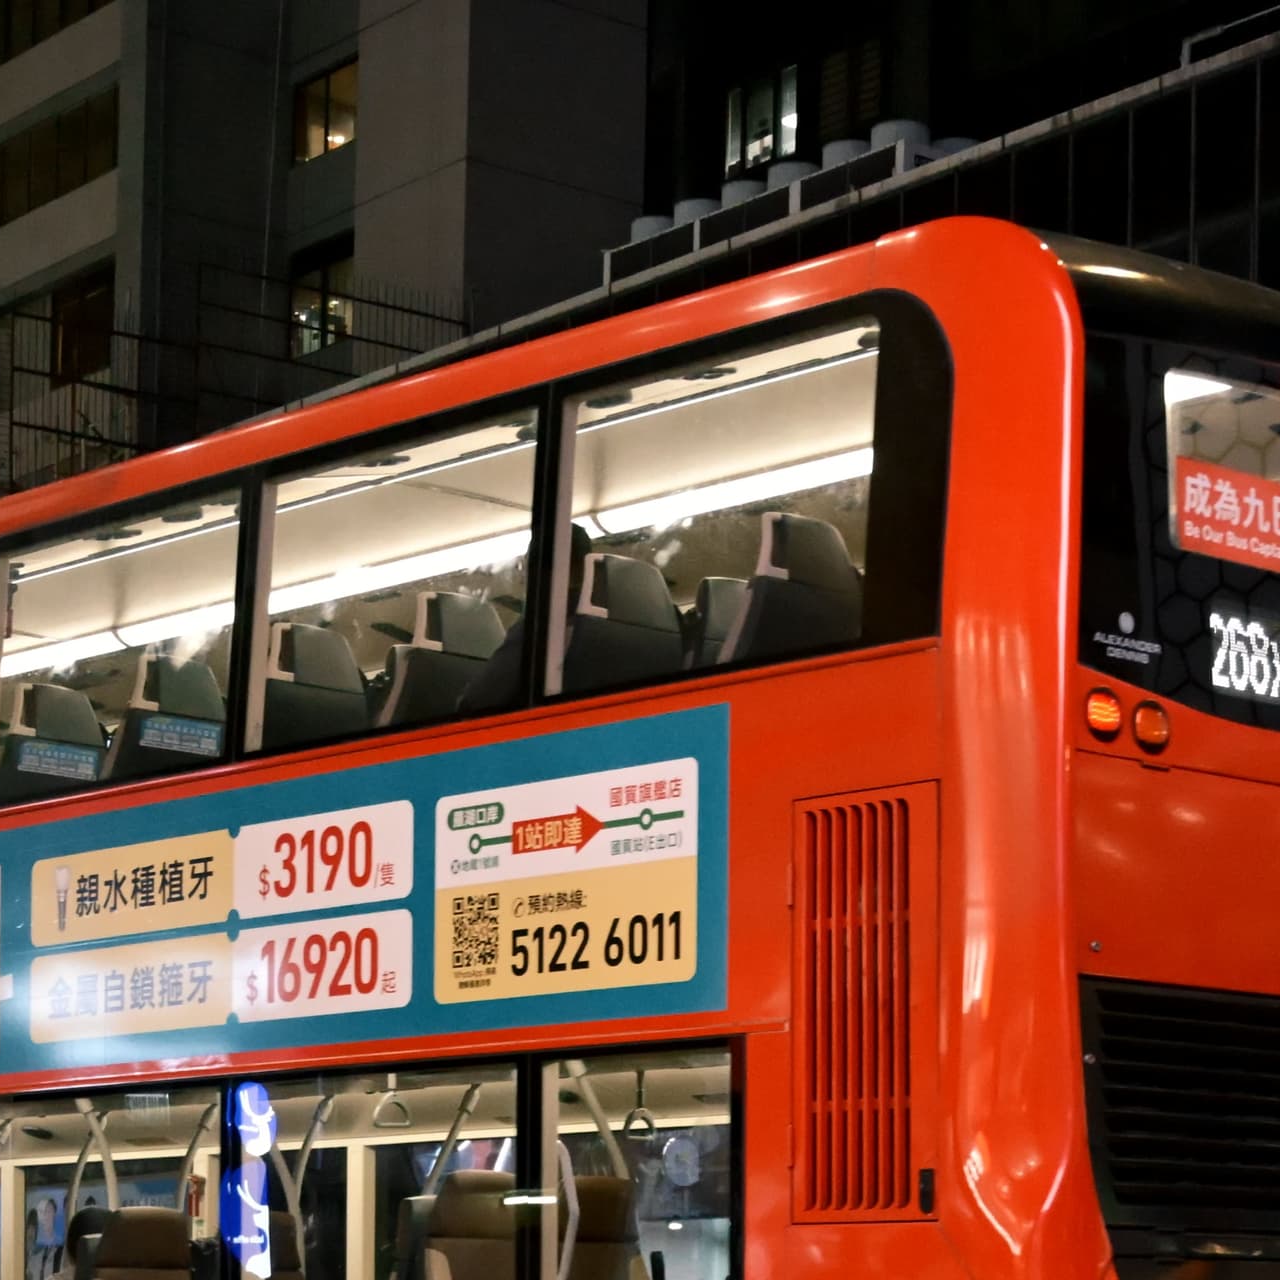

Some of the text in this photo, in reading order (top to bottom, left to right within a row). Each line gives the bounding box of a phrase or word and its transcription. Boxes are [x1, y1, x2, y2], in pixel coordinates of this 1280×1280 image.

[1184, 520, 1201, 539] Be
[1202, 525, 1224, 543] Our
[1226, 530, 1249, 550] Bus
[1093, 632, 1161, 654] ALEXANDER
[1106, 646, 1150, 665] DENNIS
[515, 816, 583, 852] 1站即達
[76, 856, 214, 917] 親水種植牙
[511, 910, 681, 976] 5122 6011
